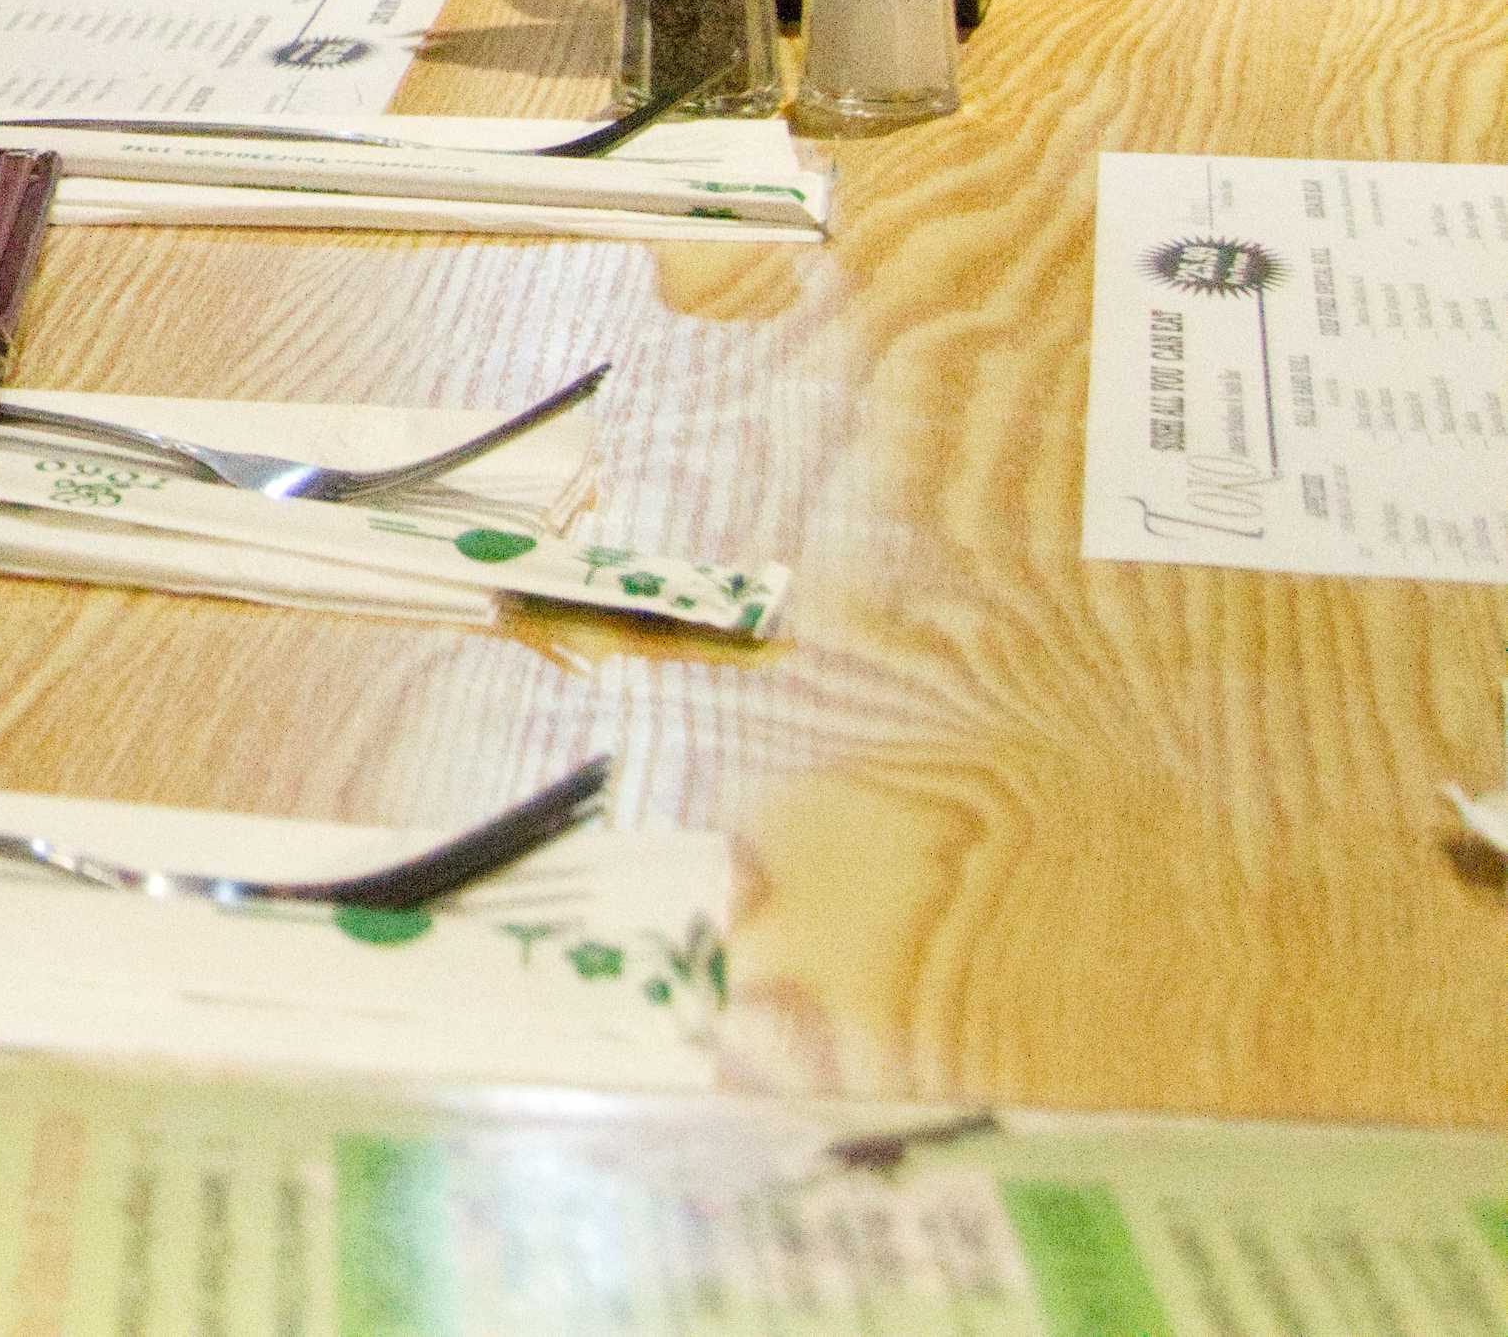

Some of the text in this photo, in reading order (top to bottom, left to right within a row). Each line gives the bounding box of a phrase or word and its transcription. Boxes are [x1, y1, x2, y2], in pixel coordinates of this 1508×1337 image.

[1149, 309, 1183, 333] EAT
[1150, 334, 1183, 361] CAN
[1150, 366, 1183, 392] YOU
